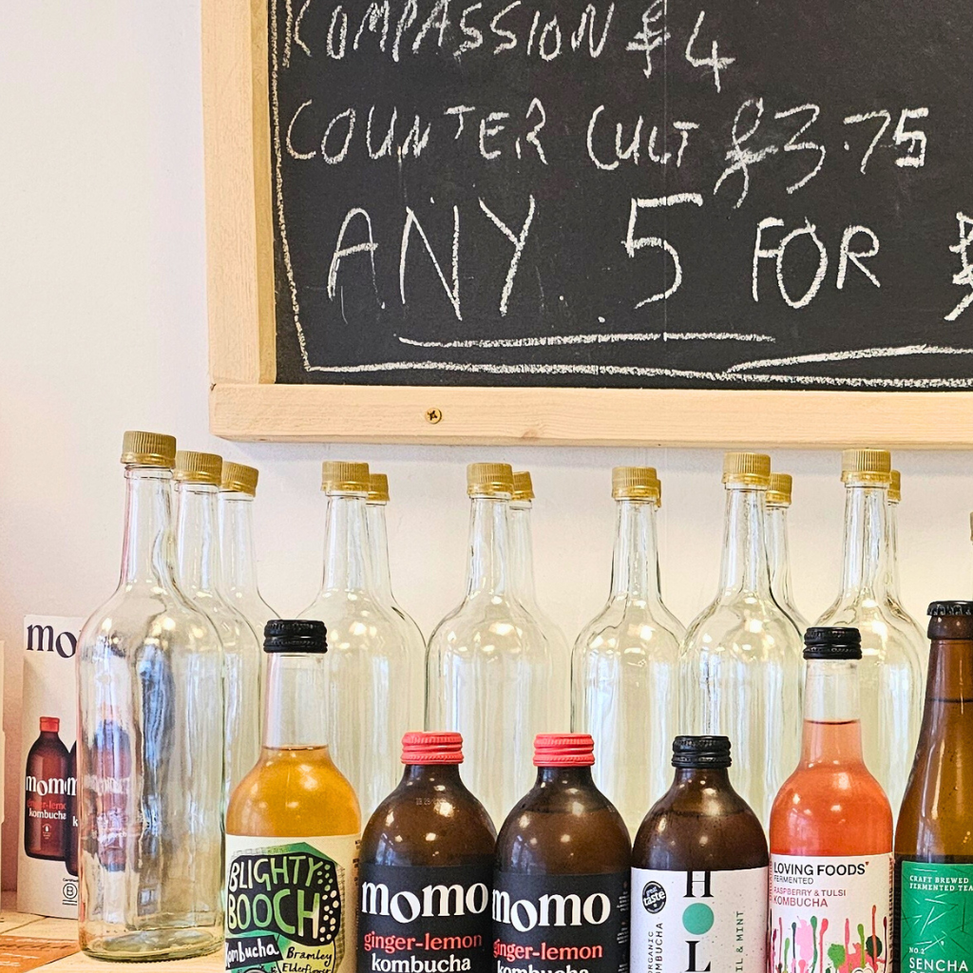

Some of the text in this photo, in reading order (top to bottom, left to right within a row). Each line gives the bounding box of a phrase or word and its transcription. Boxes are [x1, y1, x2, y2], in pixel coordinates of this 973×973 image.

[286, 98, 929, 209] COUNTER CULT £3.75
[327, 196, 534, 321] ANY
[625, 194, 702, 309] 5
[752, 217, 880, 309] FOR
[26, 624, 77, 658] mo
[229, 856, 323, 892] BLIGHTY
[774, 862, 865, 876] LOVING FOODS
[774, 875, 814, 885] FERMENTED
[909, 875, 969, 884] CRAFT BREWED
[774, 887, 846, 897] RASPBERRY TULSI
[909, 883, 973, 892] FERMENTED TEA
[362, 881, 488, 923] momo
[492, 889, 611, 932] momo
[773, 896, 828, 908] KOMBUCHA
[228, 888, 320, 939] BOOCH
[736, 911, 744, 941] MINT
[364, 931, 482, 953] ginger-lemon
[493, 938, 603, 963] ginger-lemon
[286, 947, 332, 967] Bramley
[371, 954, 471, 973] kombucha
[909, 957, 969, 972] SENCHA
